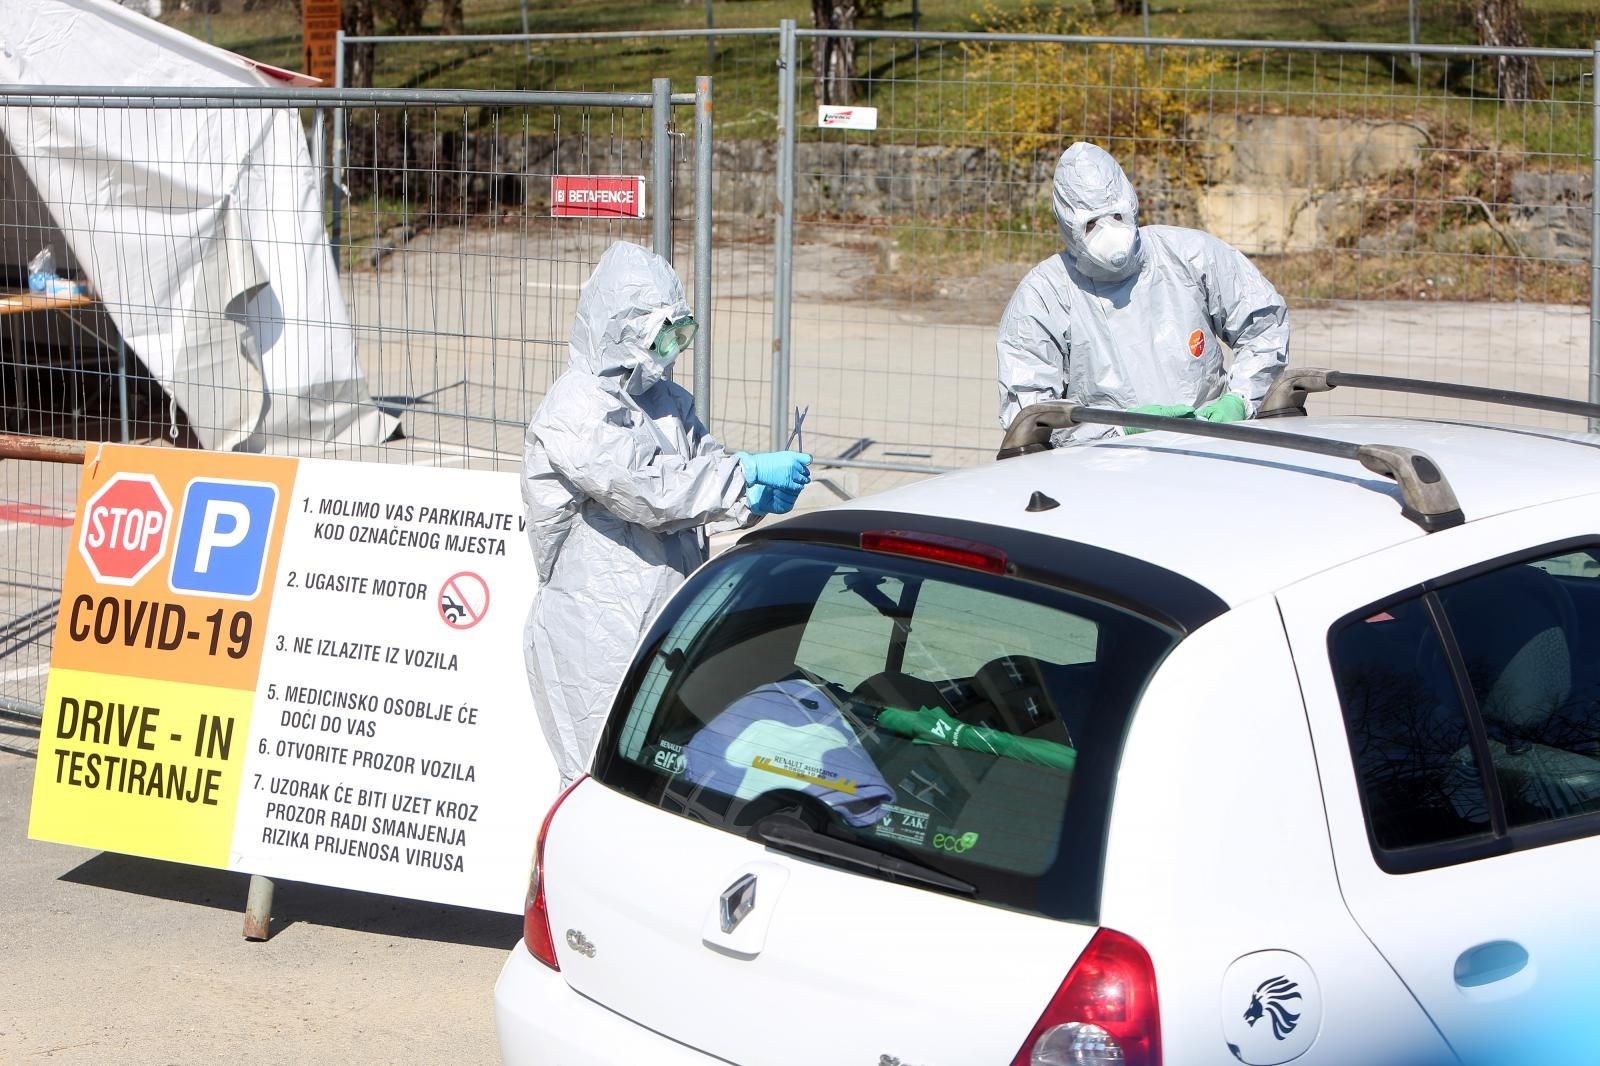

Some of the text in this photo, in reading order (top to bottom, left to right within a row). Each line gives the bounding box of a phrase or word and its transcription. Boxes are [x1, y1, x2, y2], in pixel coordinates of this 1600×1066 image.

[569, 190, 634, 203] BETAFENCE
[88, 505, 163, 551] STOP
[303, 497, 313, 514] 1.
[318, 498, 380, 519] MOLIMO
[385, 503, 414, 522] VAS
[418, 507, 513, 531] PARKIRAJTE
[193, 499, 251, 574] P
[314, 522, 506, 556] KOD OZNAČENOG MJESTA
[287, 571, 428, 600] 2. UGASITE MOTOR
[69, 593, 253, 660] COVID-19
[275, 634, 458, 671] 3. NE IZLAZITE IZ VOZILA
[267, 683, 479, 725] 5. MEDICINSKO OSOBLJE ĆE
[280, 708, 377, 738] DOĆI DO VAS
[56, 696, 160, 751] DRIVE
[194, 713, 235, 761] IN
[55, 748, 222, 806] TESTIRANJE
[258, 738, 476, 783] 6. OTVORITE PROZOR VOZILA
[654, 750, 678, 769] elf
[774, 755, 804, 769] RENAULT
[804, 764, 838, 778] assistance
[253, 773, 479, 822] 7. UZORAK ĆE BITI UZET KROZ
[266, 801, 467, 847] PROZOR RADI SMANJENJA
[262, 827, 464, 872] RIZIKA PRIJENOSA VIRUSA
